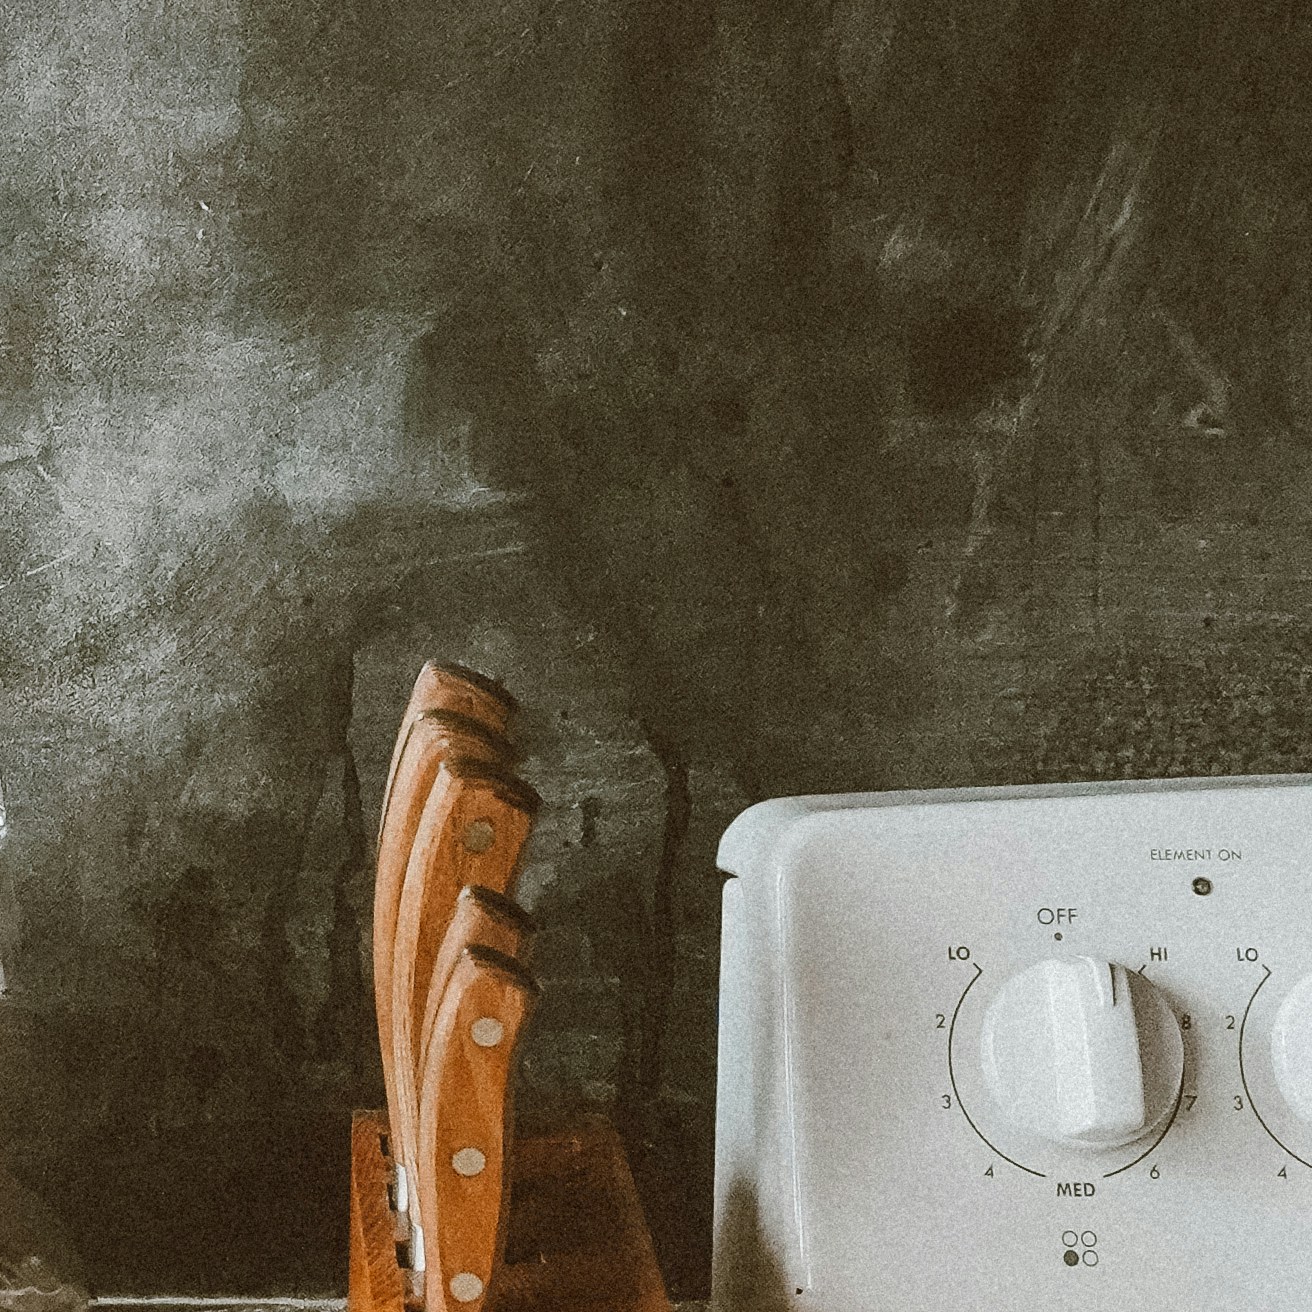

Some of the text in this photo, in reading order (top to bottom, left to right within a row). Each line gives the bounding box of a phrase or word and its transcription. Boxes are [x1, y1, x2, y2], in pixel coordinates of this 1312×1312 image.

[1150, 849, 1242, 861] ELEMENT ON
[1037, 908, 1078, 924] OFF
[948, 946, 970, 960] LO
[1150, 947, 1168, 961] HI
[1237, 947, 1258, 962] LO
[936, 1013, 946, 1029] 2
[1181, 1014, 1191, 1030] 8
[1226, 1015, 1235, 1030] 2
[941, 1094, 951, 1110] 3
[1184, 1095, 1198, 1112] 7
[1234, 1095, 1244, 1111] 3
[984, 1165, 994, 1178] 4
[1150, 1165, 1160, 1179] 6
[1278, 1166, 1287, 1179] 4
[1056, 1182, 1096, 1197] MED
